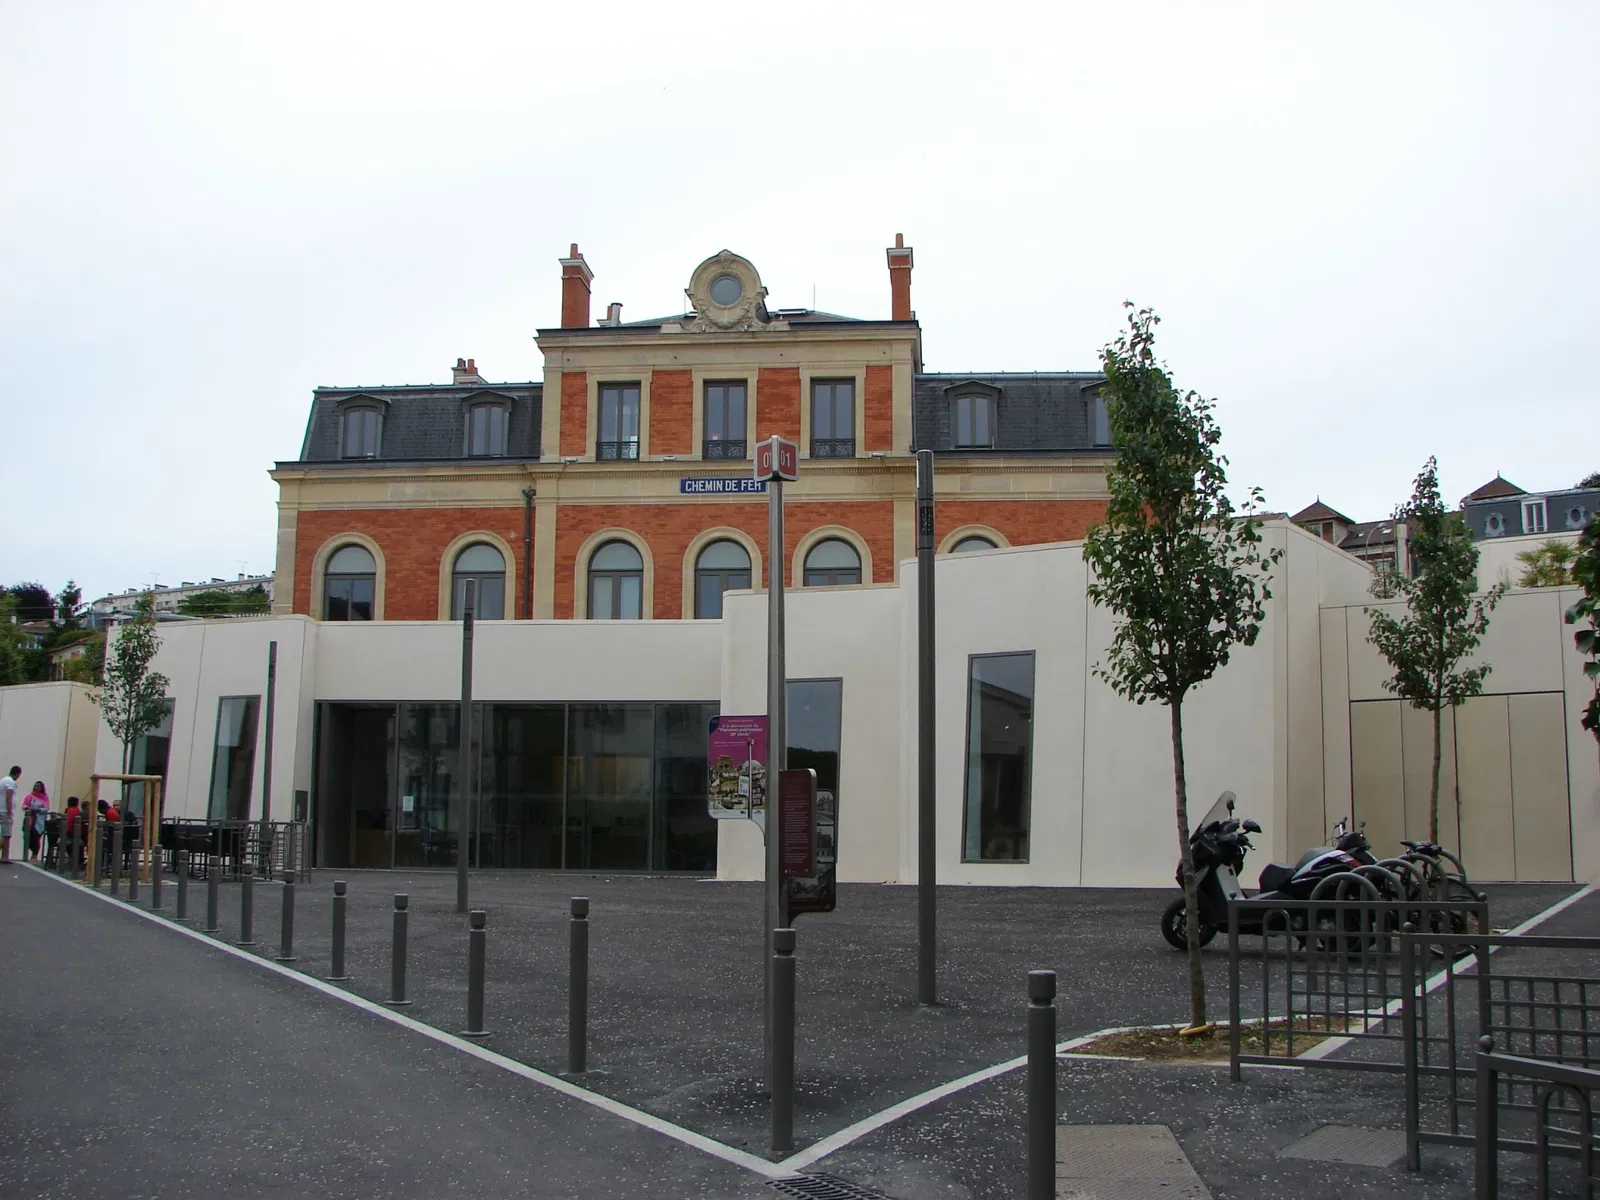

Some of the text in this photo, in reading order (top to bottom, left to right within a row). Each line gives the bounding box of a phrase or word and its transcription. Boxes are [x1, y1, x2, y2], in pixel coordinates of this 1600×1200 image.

[781, 449, 790, 468] 01
[685, 480, 723, 492] CHEMIN
[725, 480, 738, 491] DE
